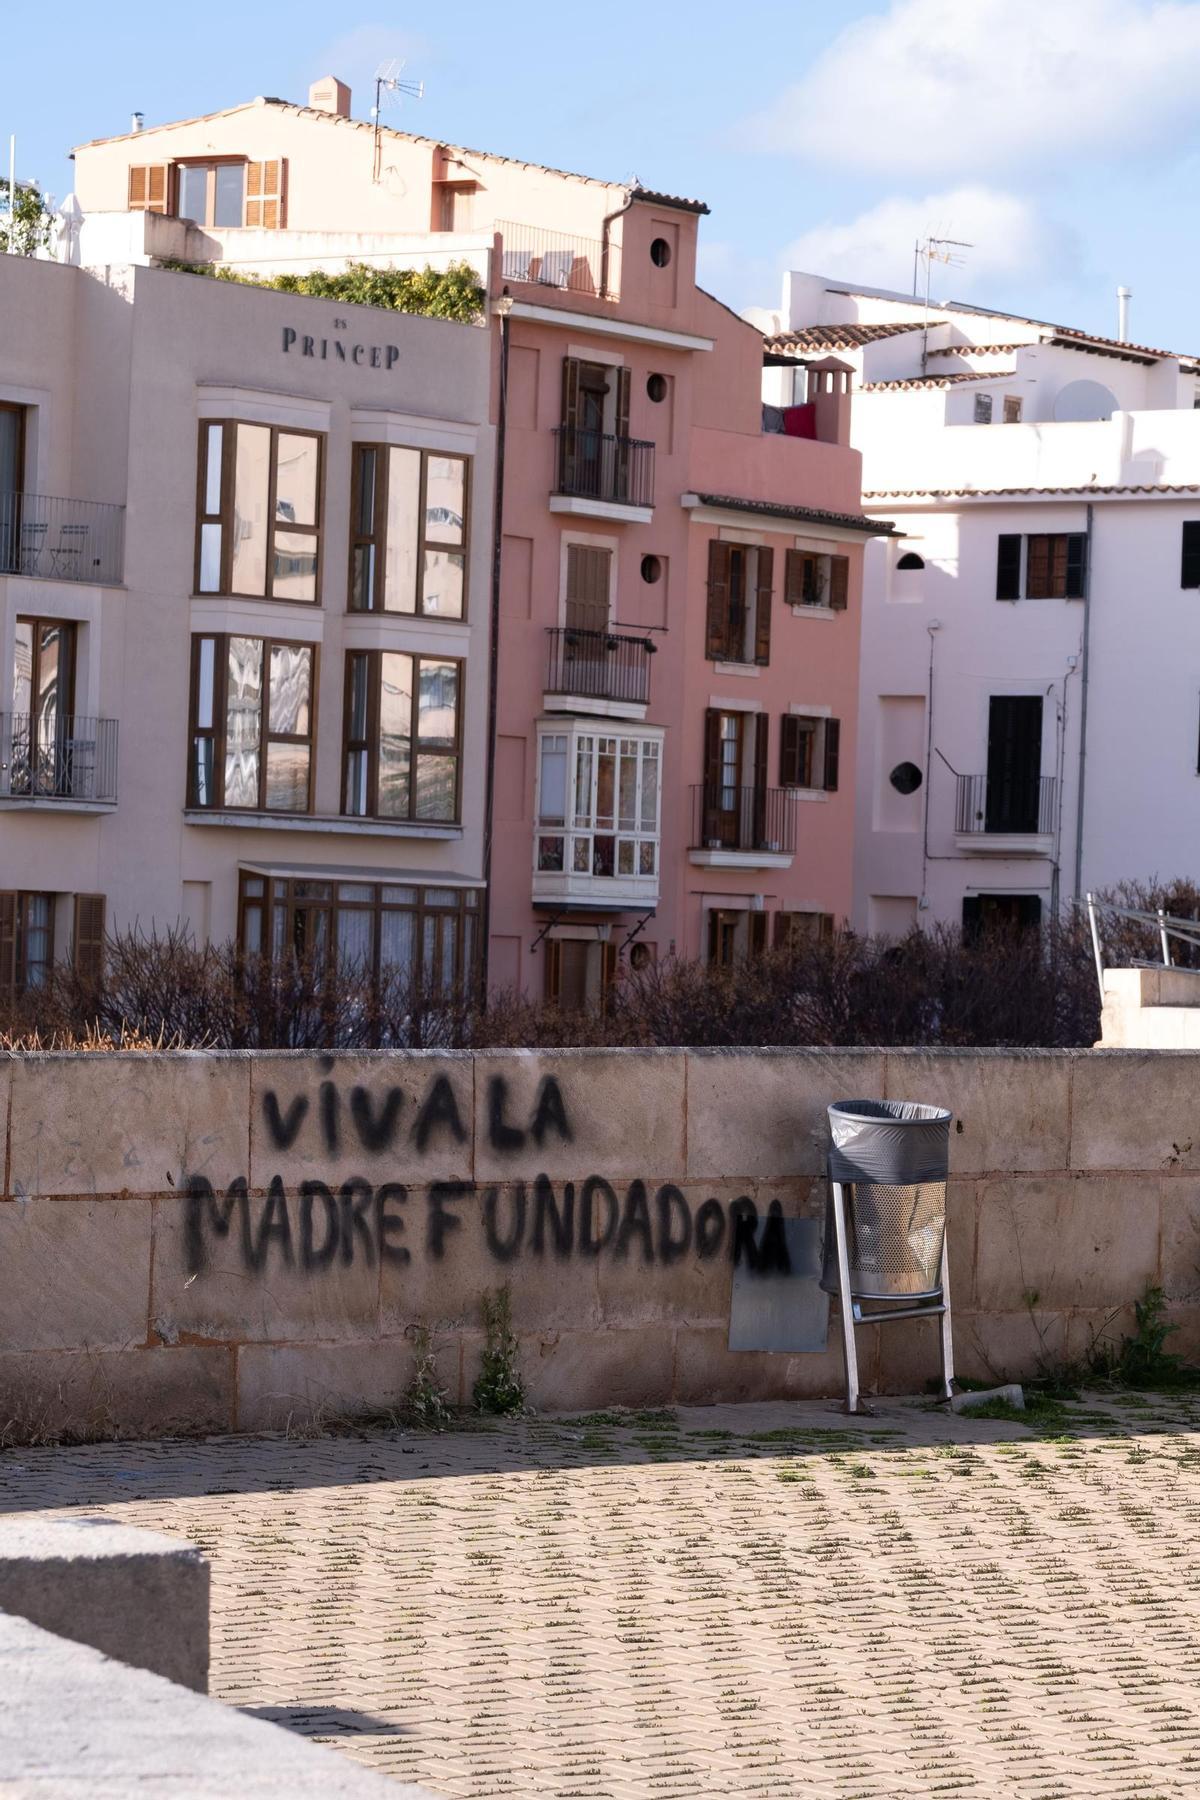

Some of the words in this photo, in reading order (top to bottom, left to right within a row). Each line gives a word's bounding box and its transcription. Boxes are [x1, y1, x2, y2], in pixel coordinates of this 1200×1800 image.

[282, 327, 399, 370] PRINCEP
[486, 1073, 573, 1152] LA
[184, 1174, 411, 1274] MADRE
